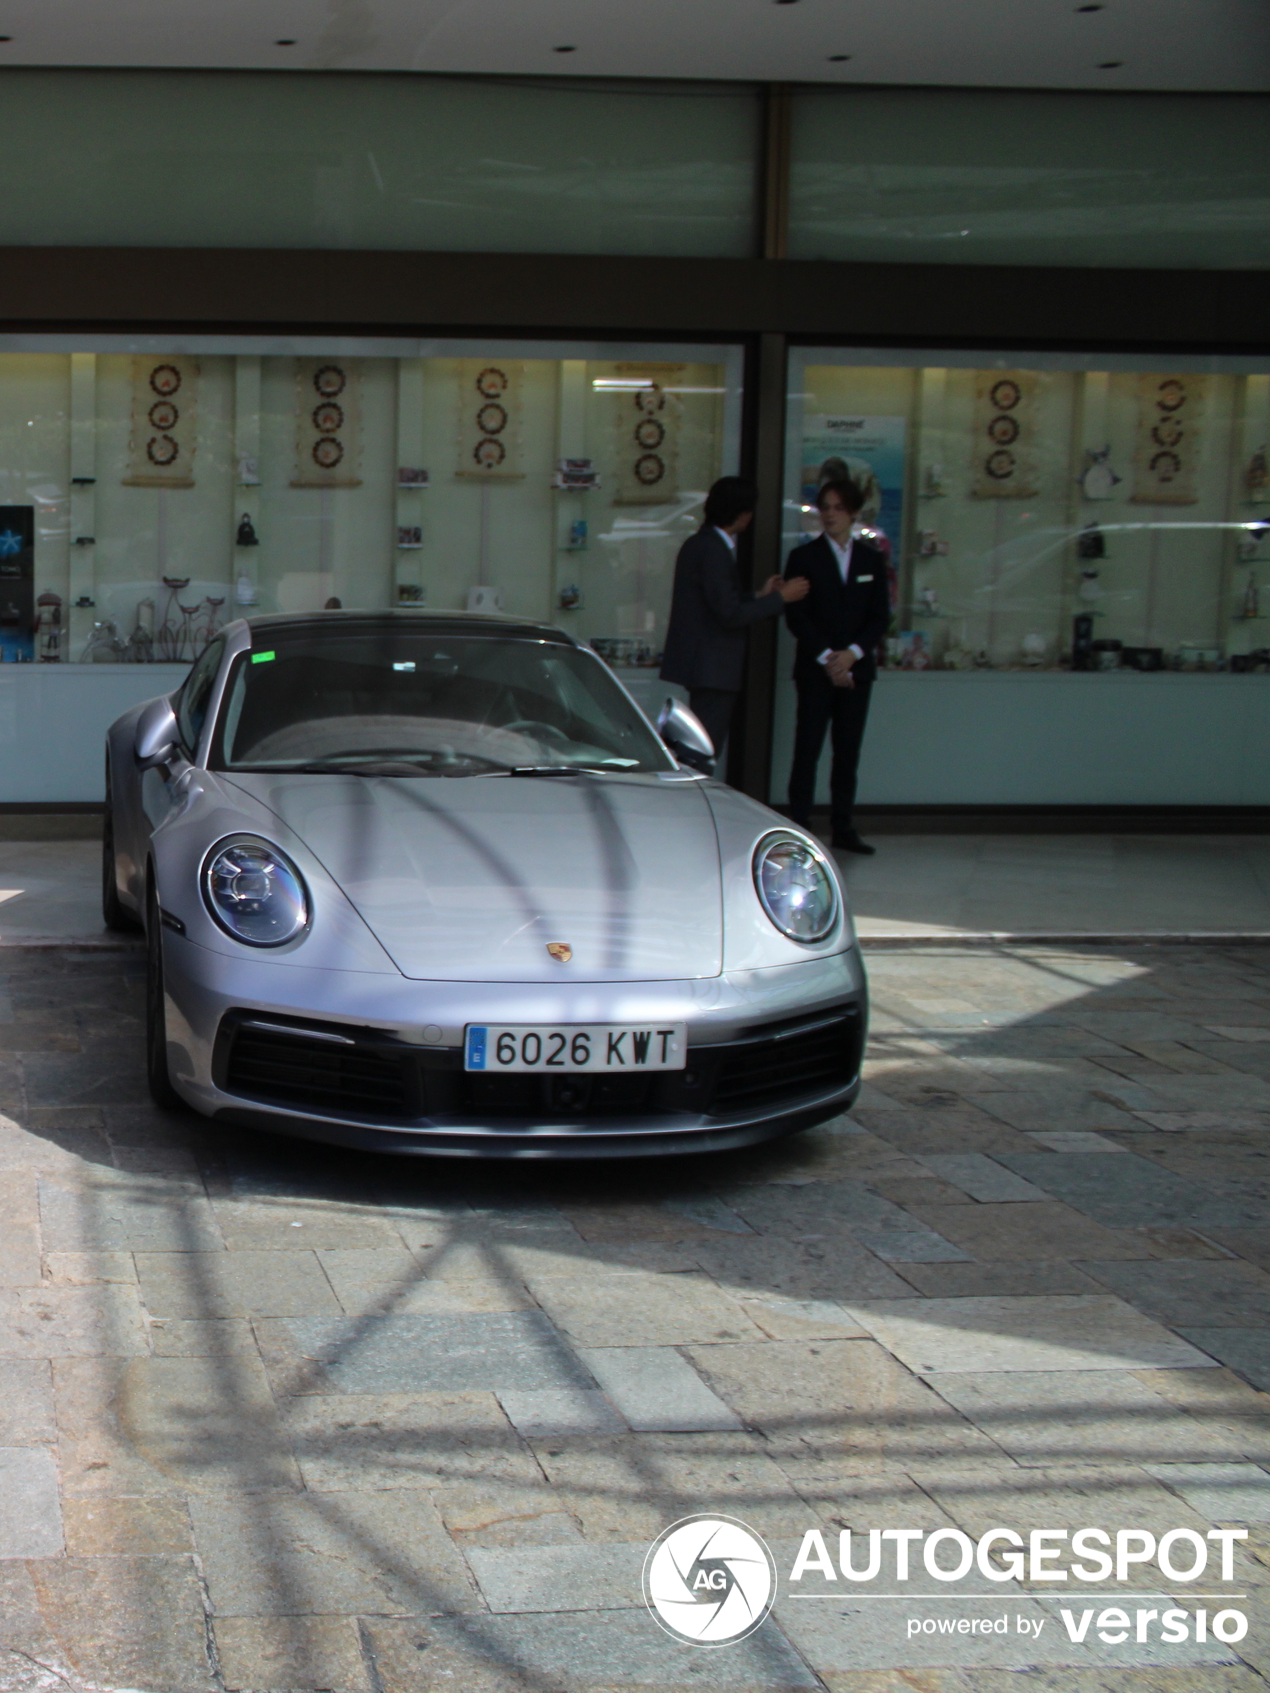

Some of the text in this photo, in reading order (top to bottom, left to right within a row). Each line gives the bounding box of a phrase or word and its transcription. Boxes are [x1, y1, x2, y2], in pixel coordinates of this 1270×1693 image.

[473, 1053, 481, 1063] E
[496, 1030, 675, 1066] 6026 KWT
